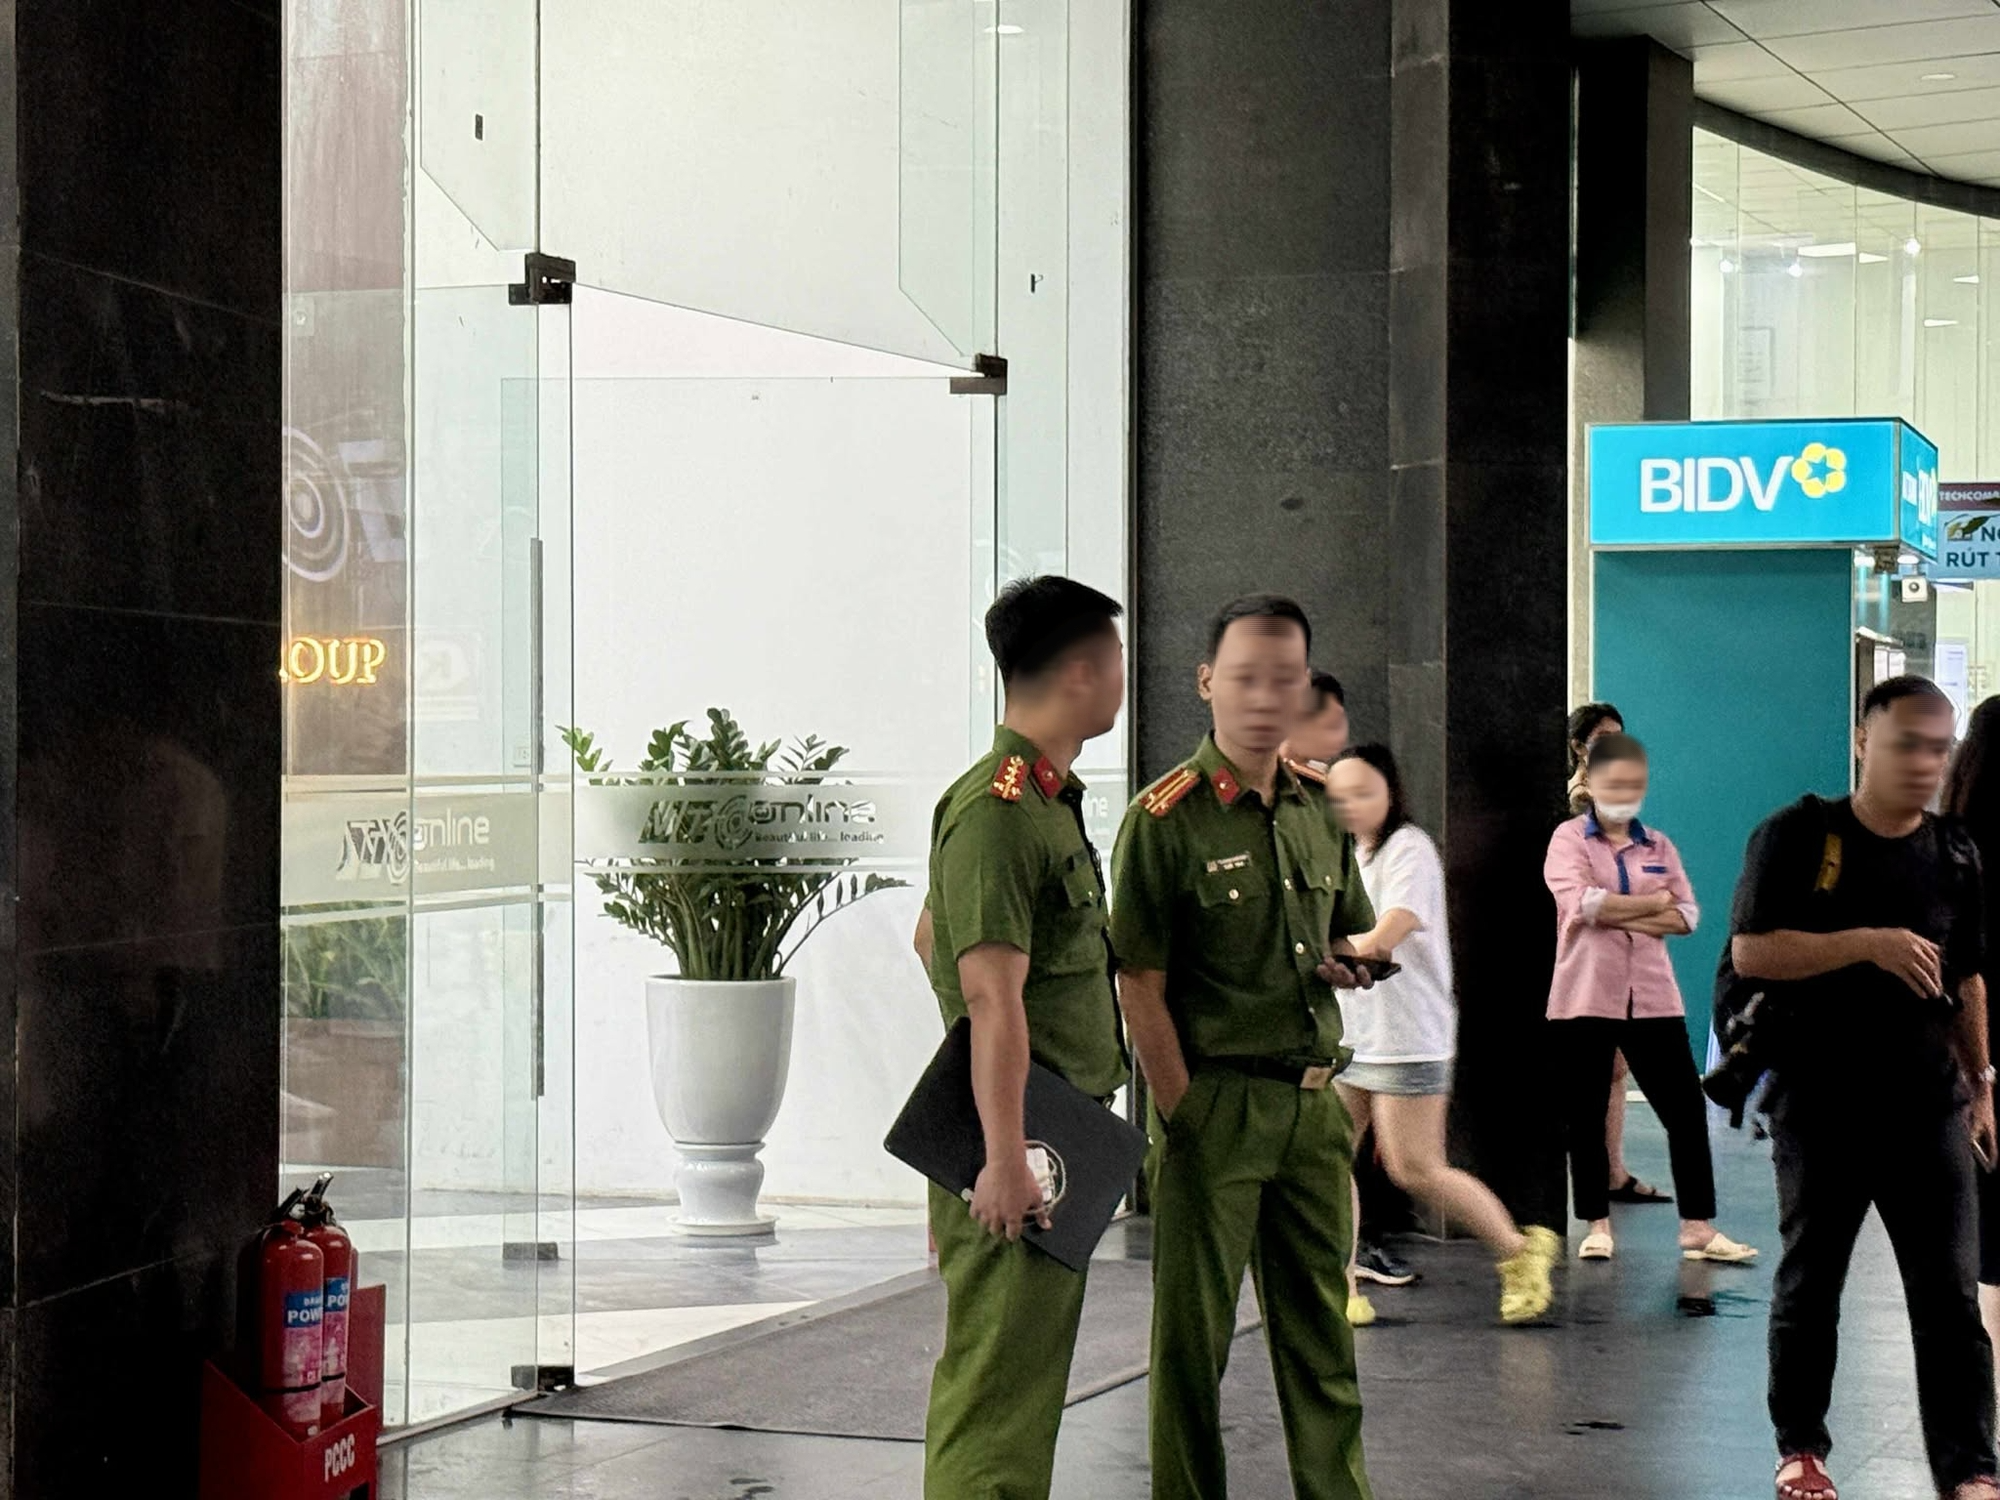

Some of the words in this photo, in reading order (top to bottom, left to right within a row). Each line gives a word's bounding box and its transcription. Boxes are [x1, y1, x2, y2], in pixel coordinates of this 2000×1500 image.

[1640, 456, 1795, 513] BIDV
[1946, 546, 1990, 567] RÚT
[279, 637, 385, 684] OUP
